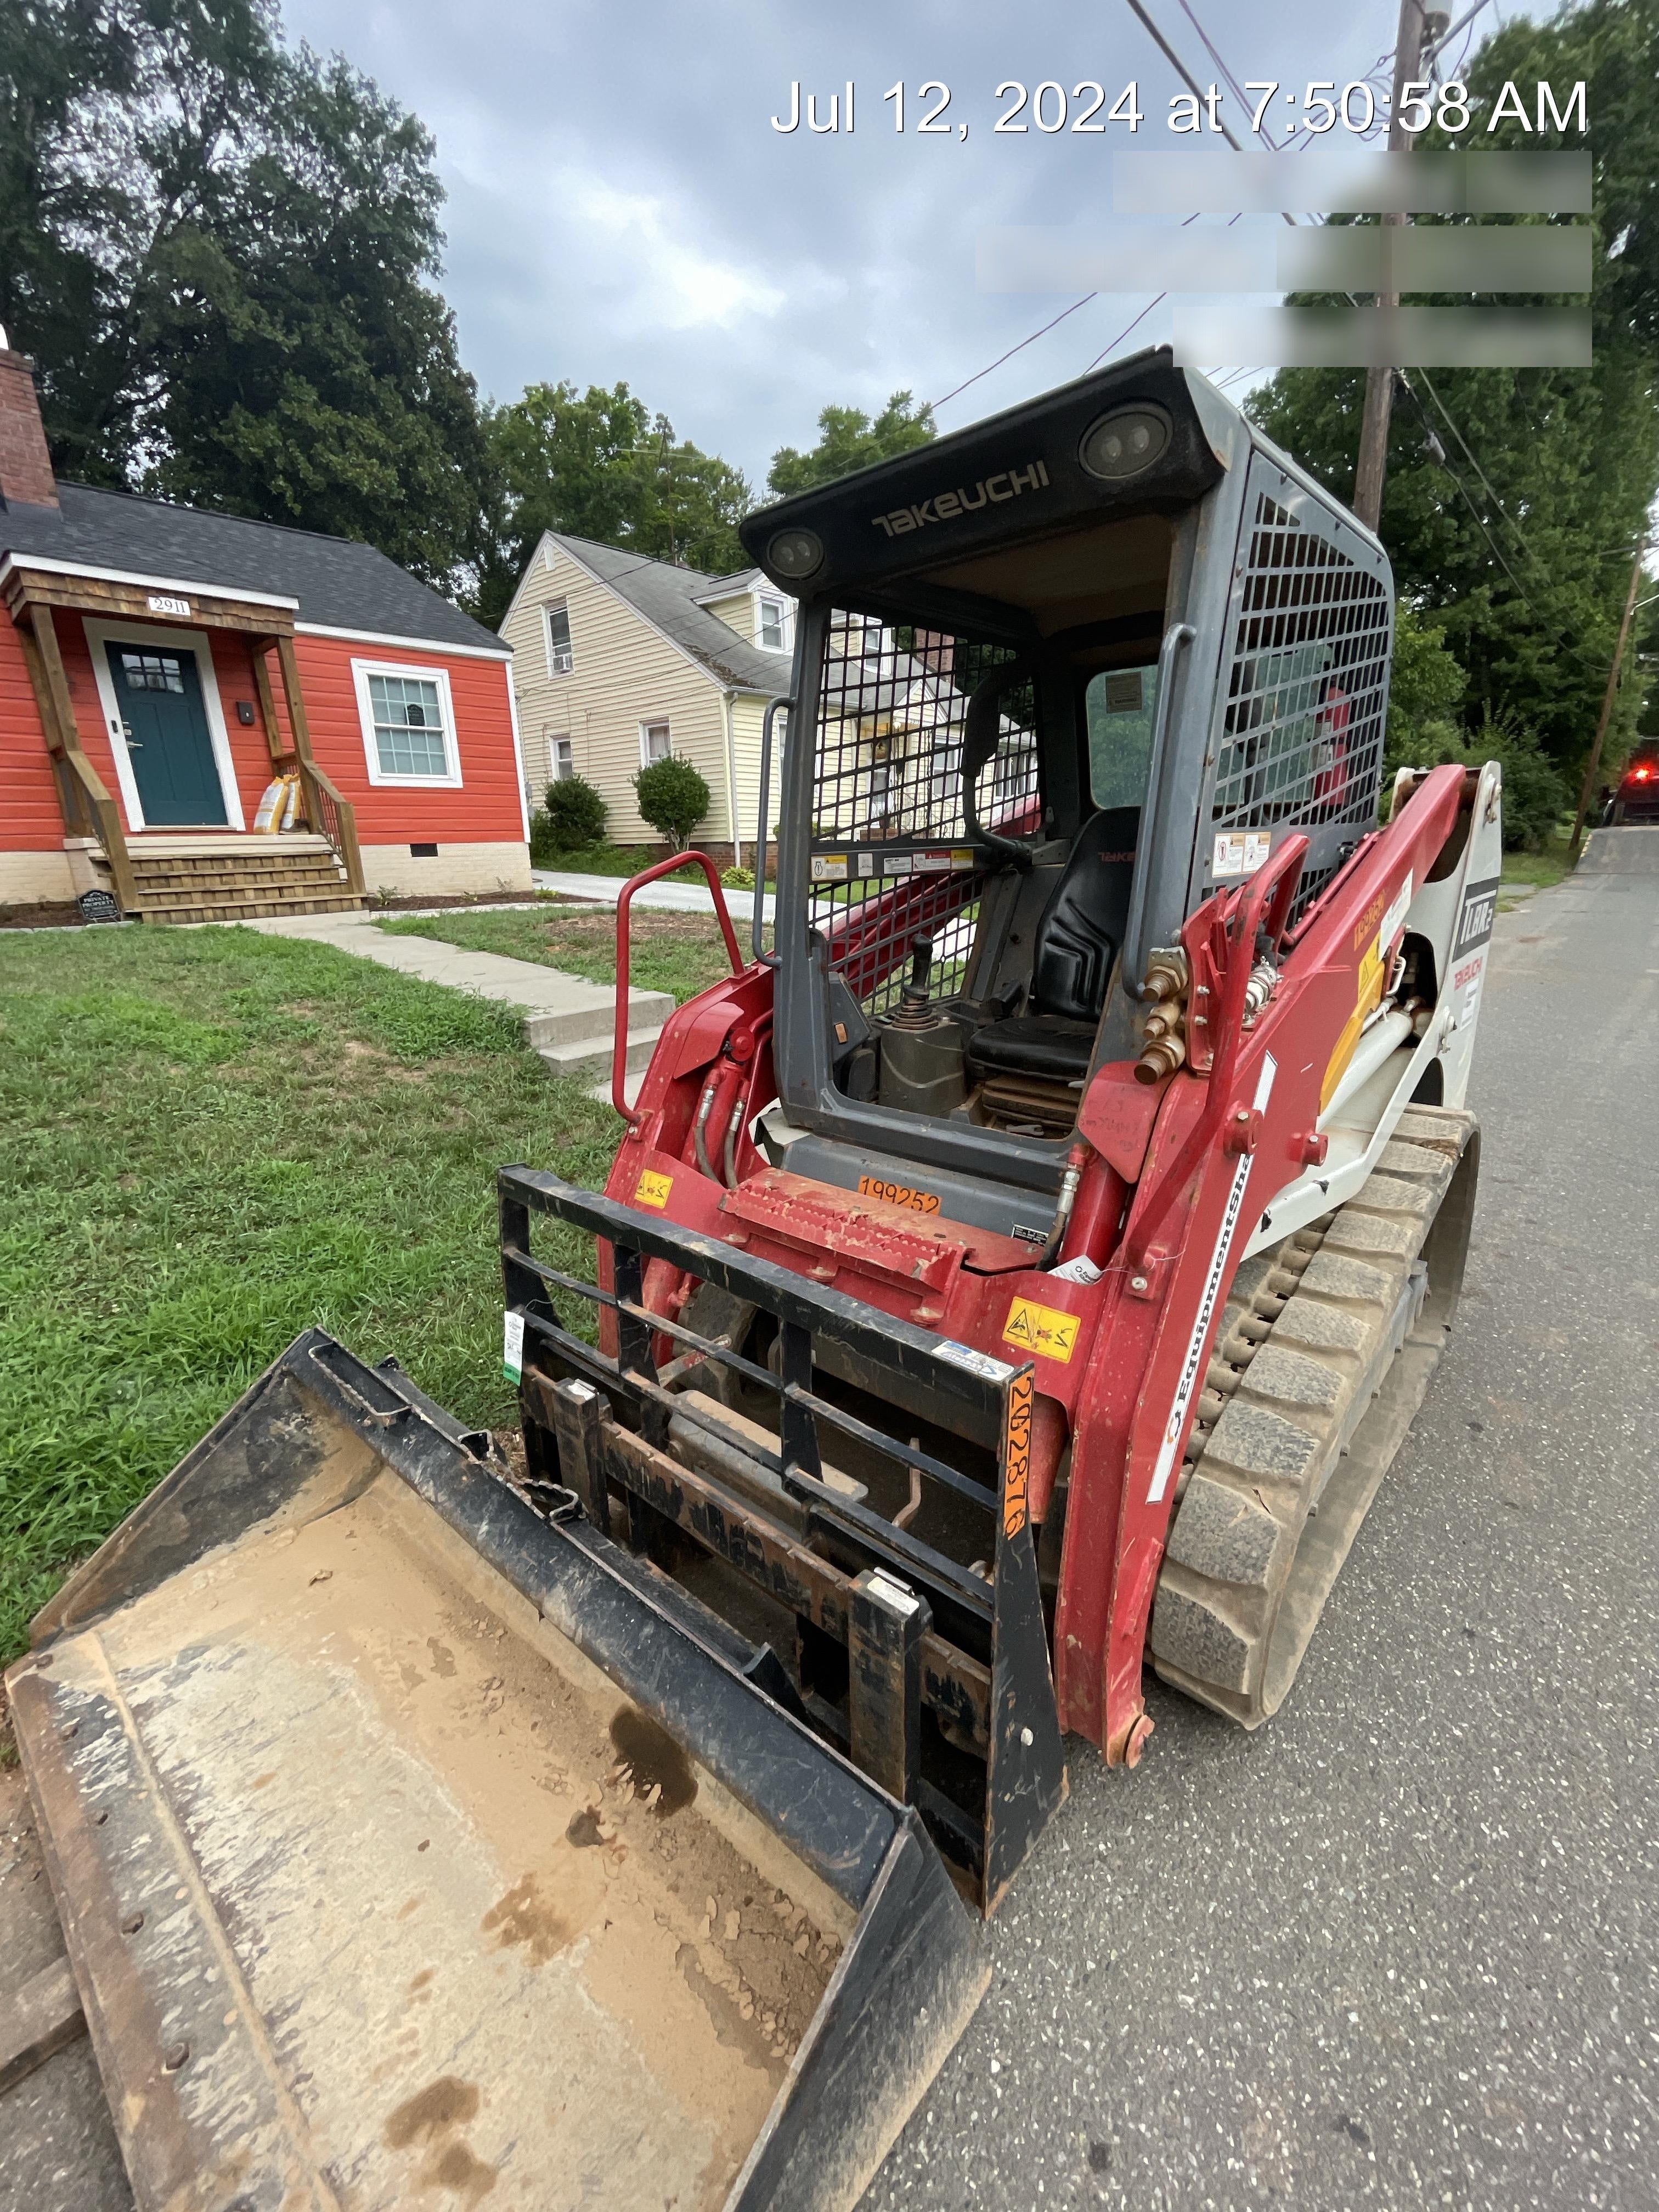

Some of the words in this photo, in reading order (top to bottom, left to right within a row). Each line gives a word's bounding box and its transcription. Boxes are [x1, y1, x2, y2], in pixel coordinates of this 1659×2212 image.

[154, 598, 186, 613] 2911
[862, 1178, 940, 1214] 199252
[1005, 1376, 1032, 1536] 202876
